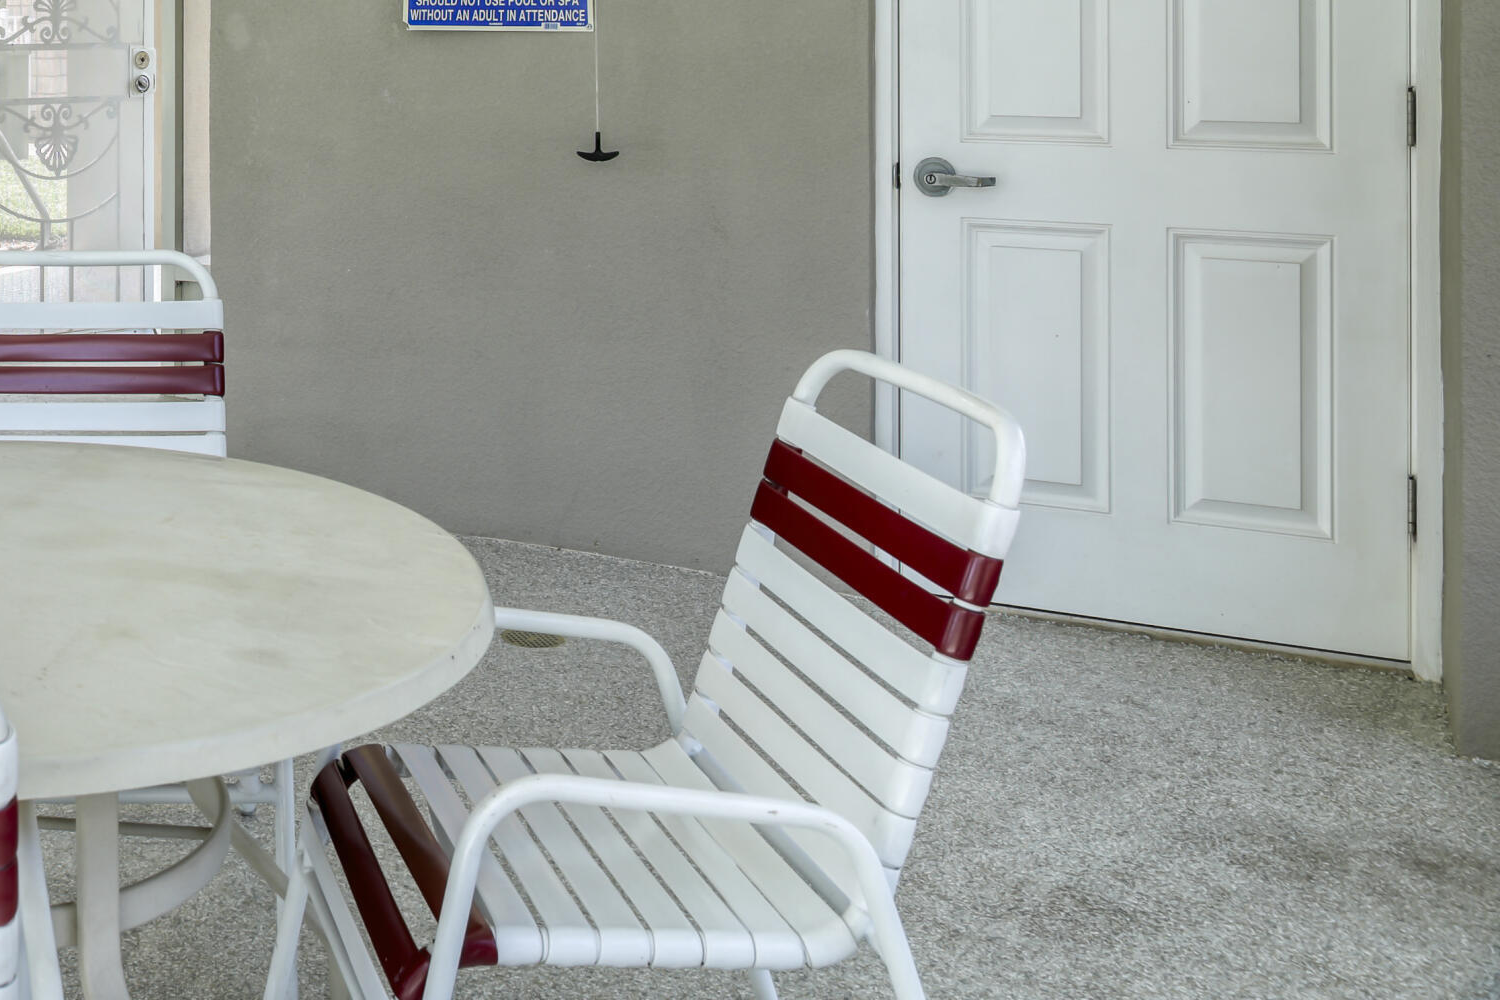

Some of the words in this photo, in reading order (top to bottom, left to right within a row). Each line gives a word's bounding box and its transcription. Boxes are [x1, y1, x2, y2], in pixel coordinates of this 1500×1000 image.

[411, 9, 454, 20] WITHOUT
[456, 10, 469, 21] AN
[472, 10, 504, 21] ADULT
[507, 10, 516, 21] IN
[519, 10, 585, 21] ATTENDANCE
